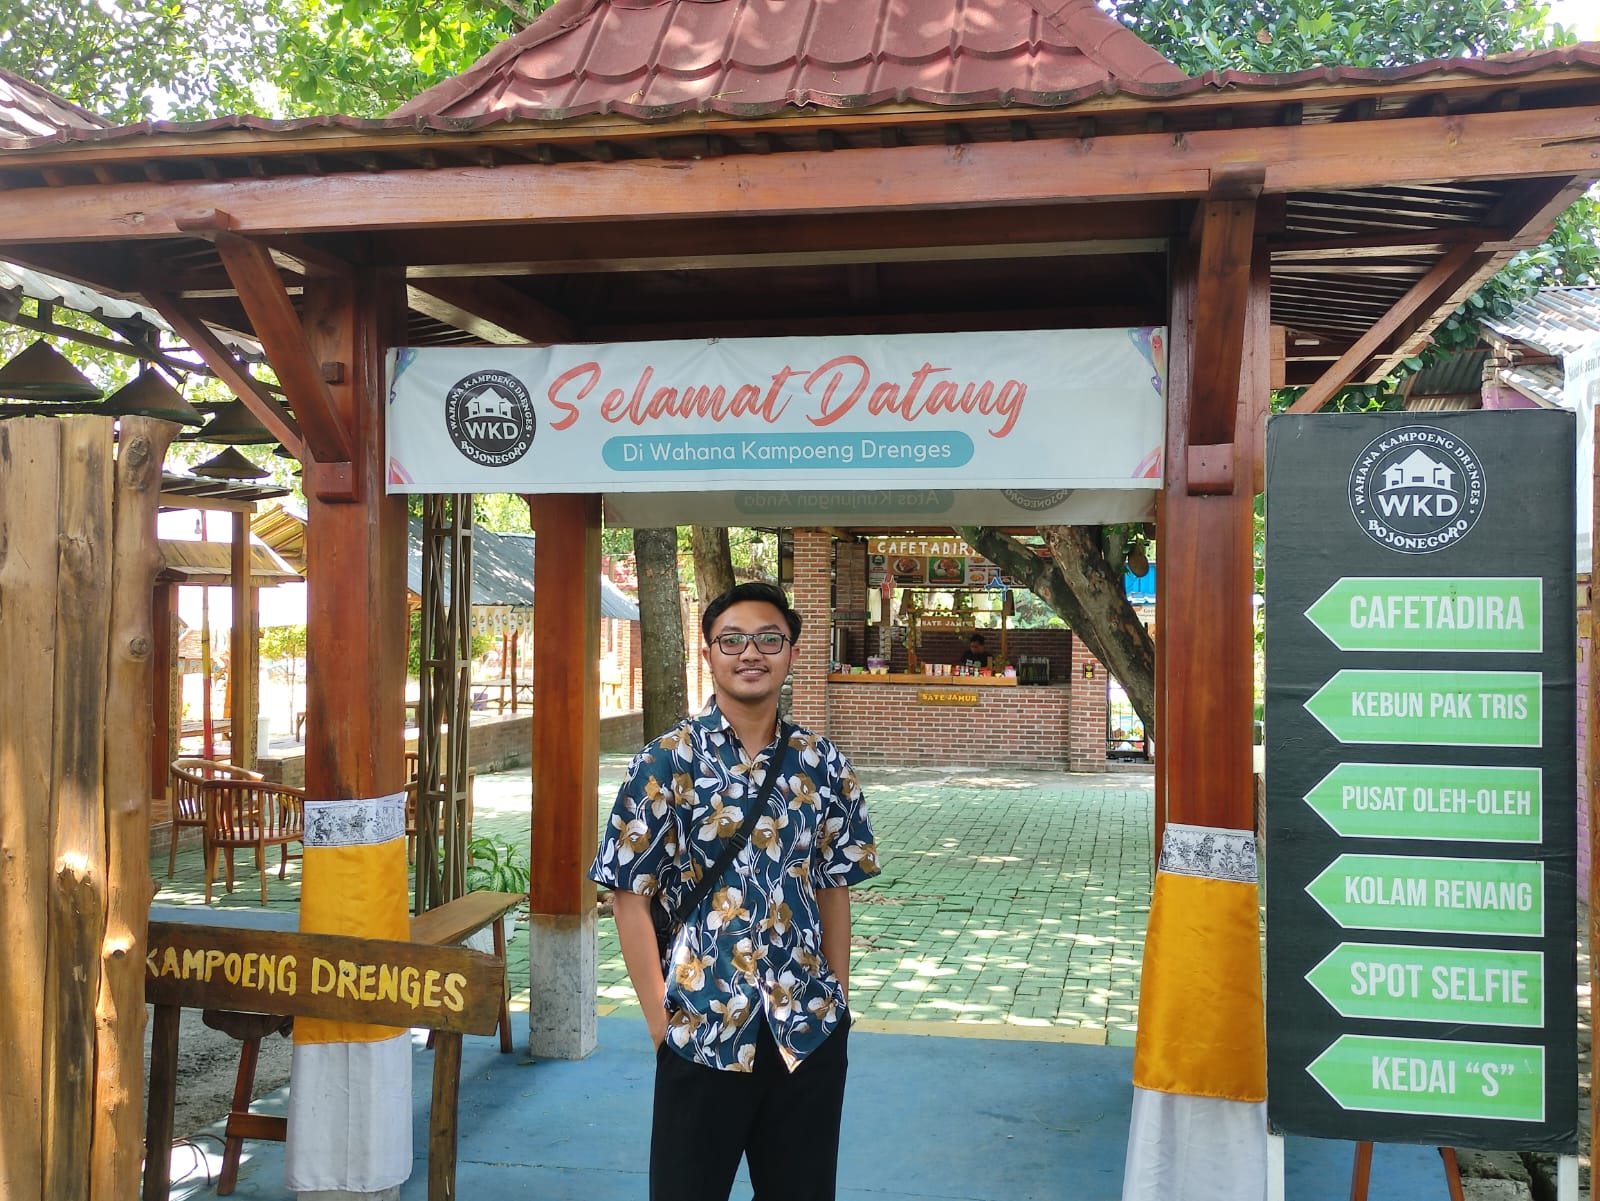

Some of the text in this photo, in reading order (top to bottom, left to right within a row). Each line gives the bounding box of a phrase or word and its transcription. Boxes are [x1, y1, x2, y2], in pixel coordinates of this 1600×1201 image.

[449, 374, 533, 431] WAHANA KAMPOENG DRENGES
[547, 354, 1028, 438] Selamat Datang
[465, 421, 519, 440] WKD
[461, 440, 527, 464] BOJONEGORO
[622, 439, 952, 464] Di Wahana Kampoeng Drenges
[1355, 431, 1481, 506] WAHANA KAMPOENG DRENGES
[1378, 494, 1458, 517] WKD
[1368, 519, 1468, 549] BOJONEGORO
[1350, 595, 1524, 630] CAFETADIRA
[922, 693, 945, 701] SATE
[1352, 692, 1528, 720] KEBUN PAK TRIS
[1343, 785, 1531, 816] PUSAT OLEH-OLEH
[1345, 875, 1532, 911] KOLAM RENANG
[311, 957, 467, 1012] DRENGES
[1350, 962, 1529, 1004] SPOT SELFIE
[1372, 1055, 1455, 1094] KEDAI
